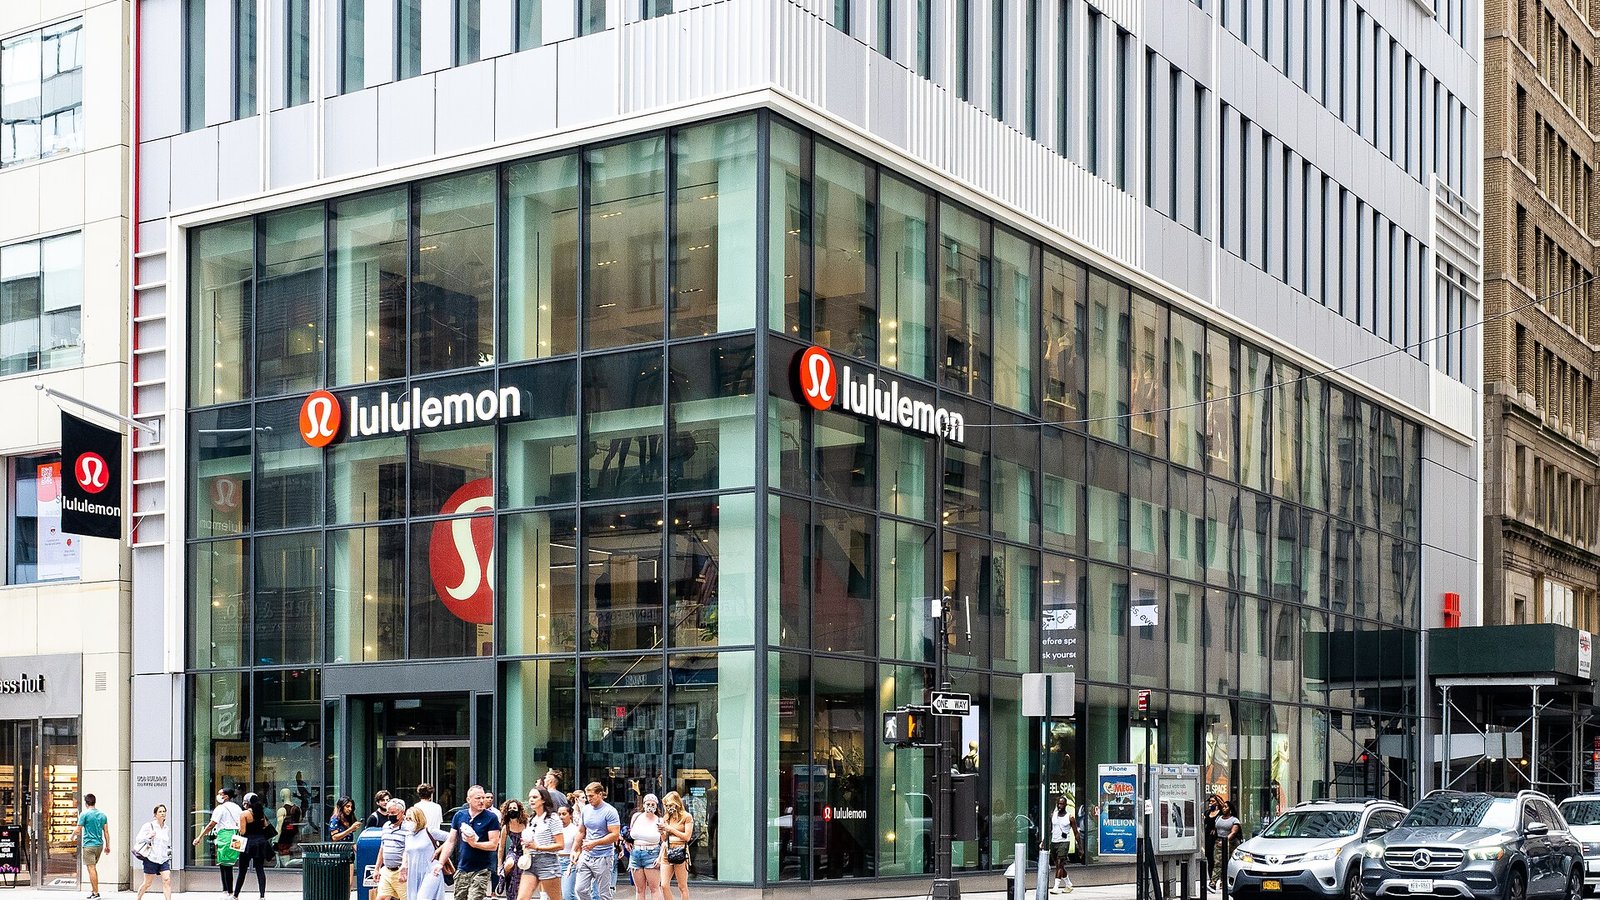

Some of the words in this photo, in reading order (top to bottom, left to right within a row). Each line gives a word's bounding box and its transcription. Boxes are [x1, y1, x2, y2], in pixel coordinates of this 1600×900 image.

[843, 366, 964, 443] lululemon
[350, 387, 521, 437] lululemon
[62, 496, 121, 517] lululemon
[1057, 610, 1072, 624] Get
[20, 672, 46, 693] hut
[936, 699, 949, 709] ONE
[953, 700, 967, 709] WAY
[1212, 784, 1227, 794] SPACE
[833, 807, 867, 819] lululemon
[1103, 819, 1135, 827] MILLION
